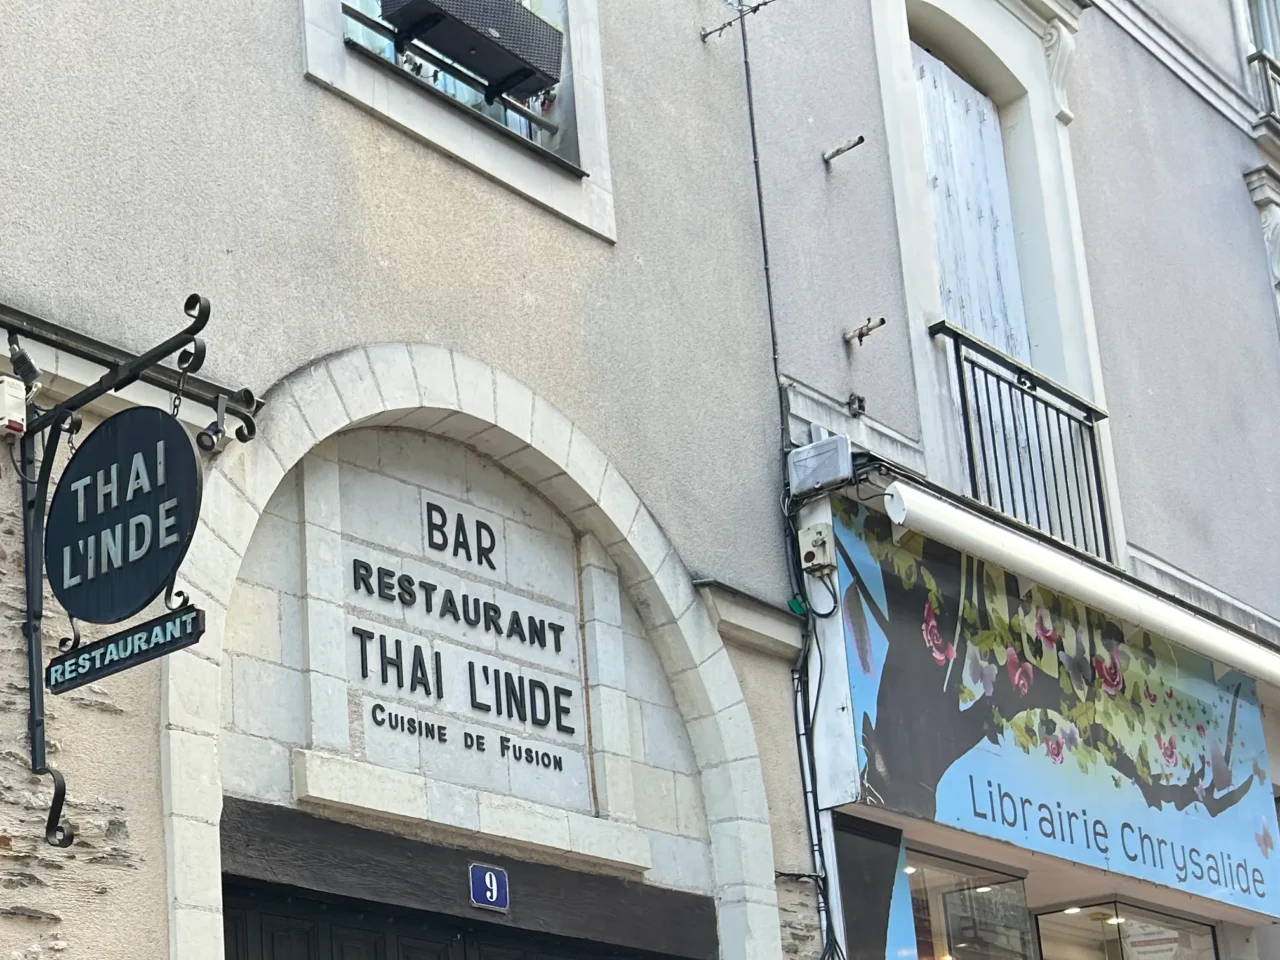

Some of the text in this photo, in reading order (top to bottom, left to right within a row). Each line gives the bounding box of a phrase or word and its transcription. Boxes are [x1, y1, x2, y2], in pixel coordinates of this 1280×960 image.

[71, 440, 166, 523] THAI
[62, 497, 180, 590] L'INDE
[426, 501, 496, 570] BAR
[50, 611, 198, 687] RESTAURANT
[353, 558, 565, 653] RESTAURANT
[352, 626, 575, 735] THAI L'INDE
[968, 774, 1266, 899] Librairie Chrysalide
[485, 871, 498, 902] 9
